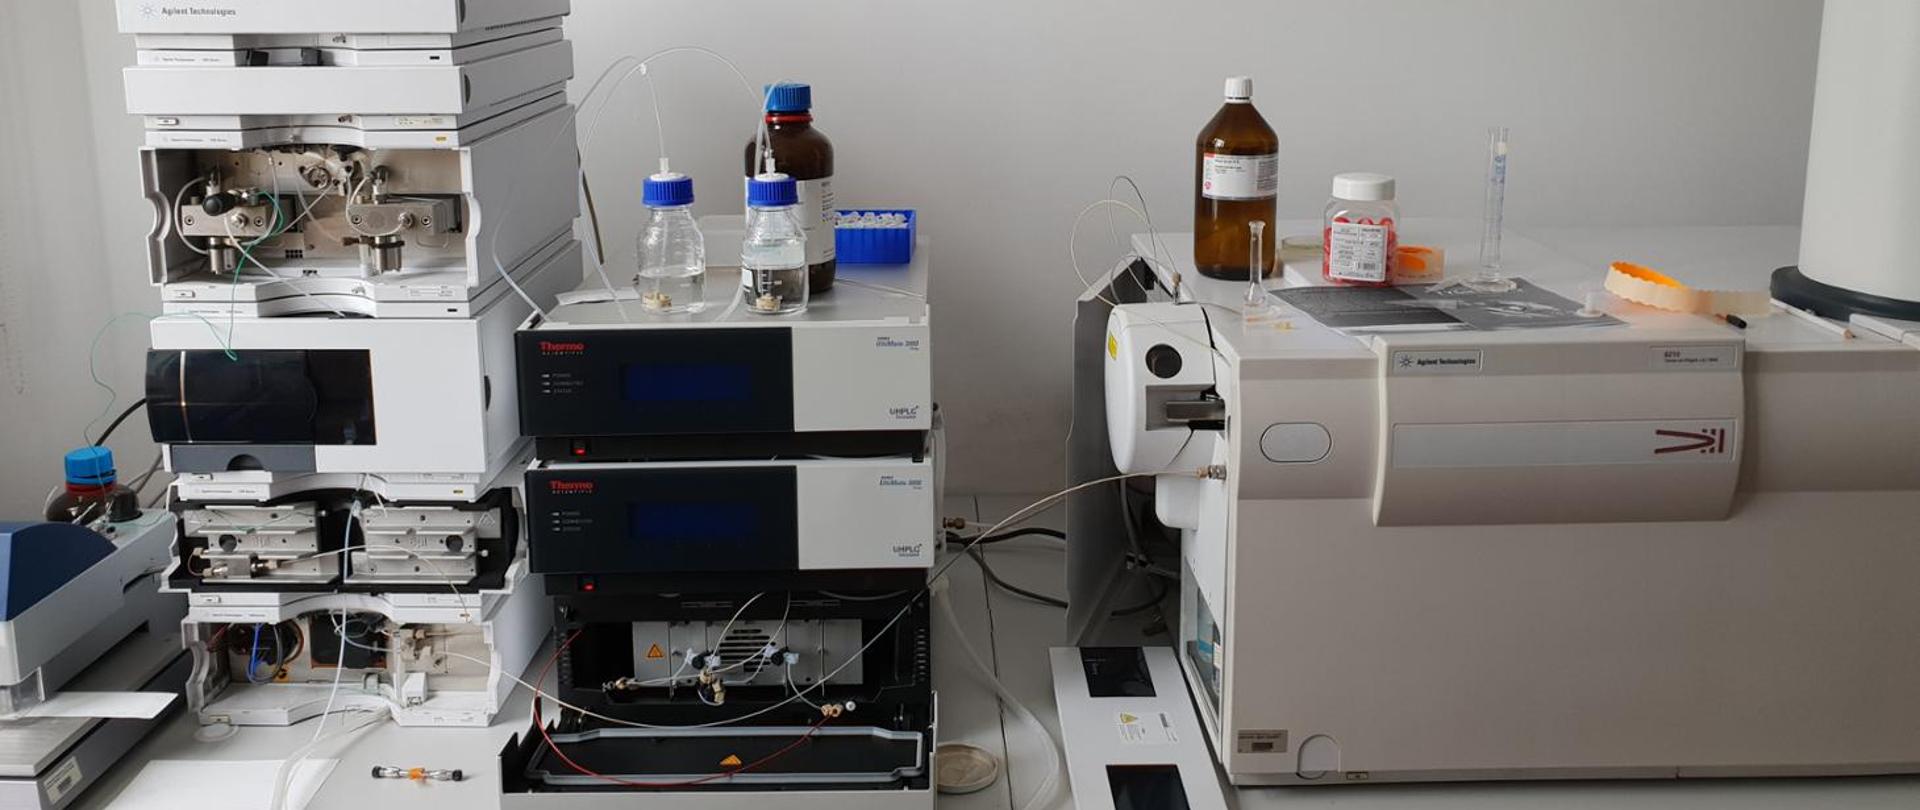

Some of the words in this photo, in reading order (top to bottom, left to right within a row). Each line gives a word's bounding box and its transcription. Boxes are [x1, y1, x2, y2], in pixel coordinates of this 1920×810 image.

[161, 7, 188, 16] Agilent
[189, 7, 236, 16] Technologies
[541, 342, 585, 351] Thermo
[1417, 358, 1438, 366] Agilent
[1439, 358, 1476, 366] Technologies
[549, 480, 593, 490] Thermo
